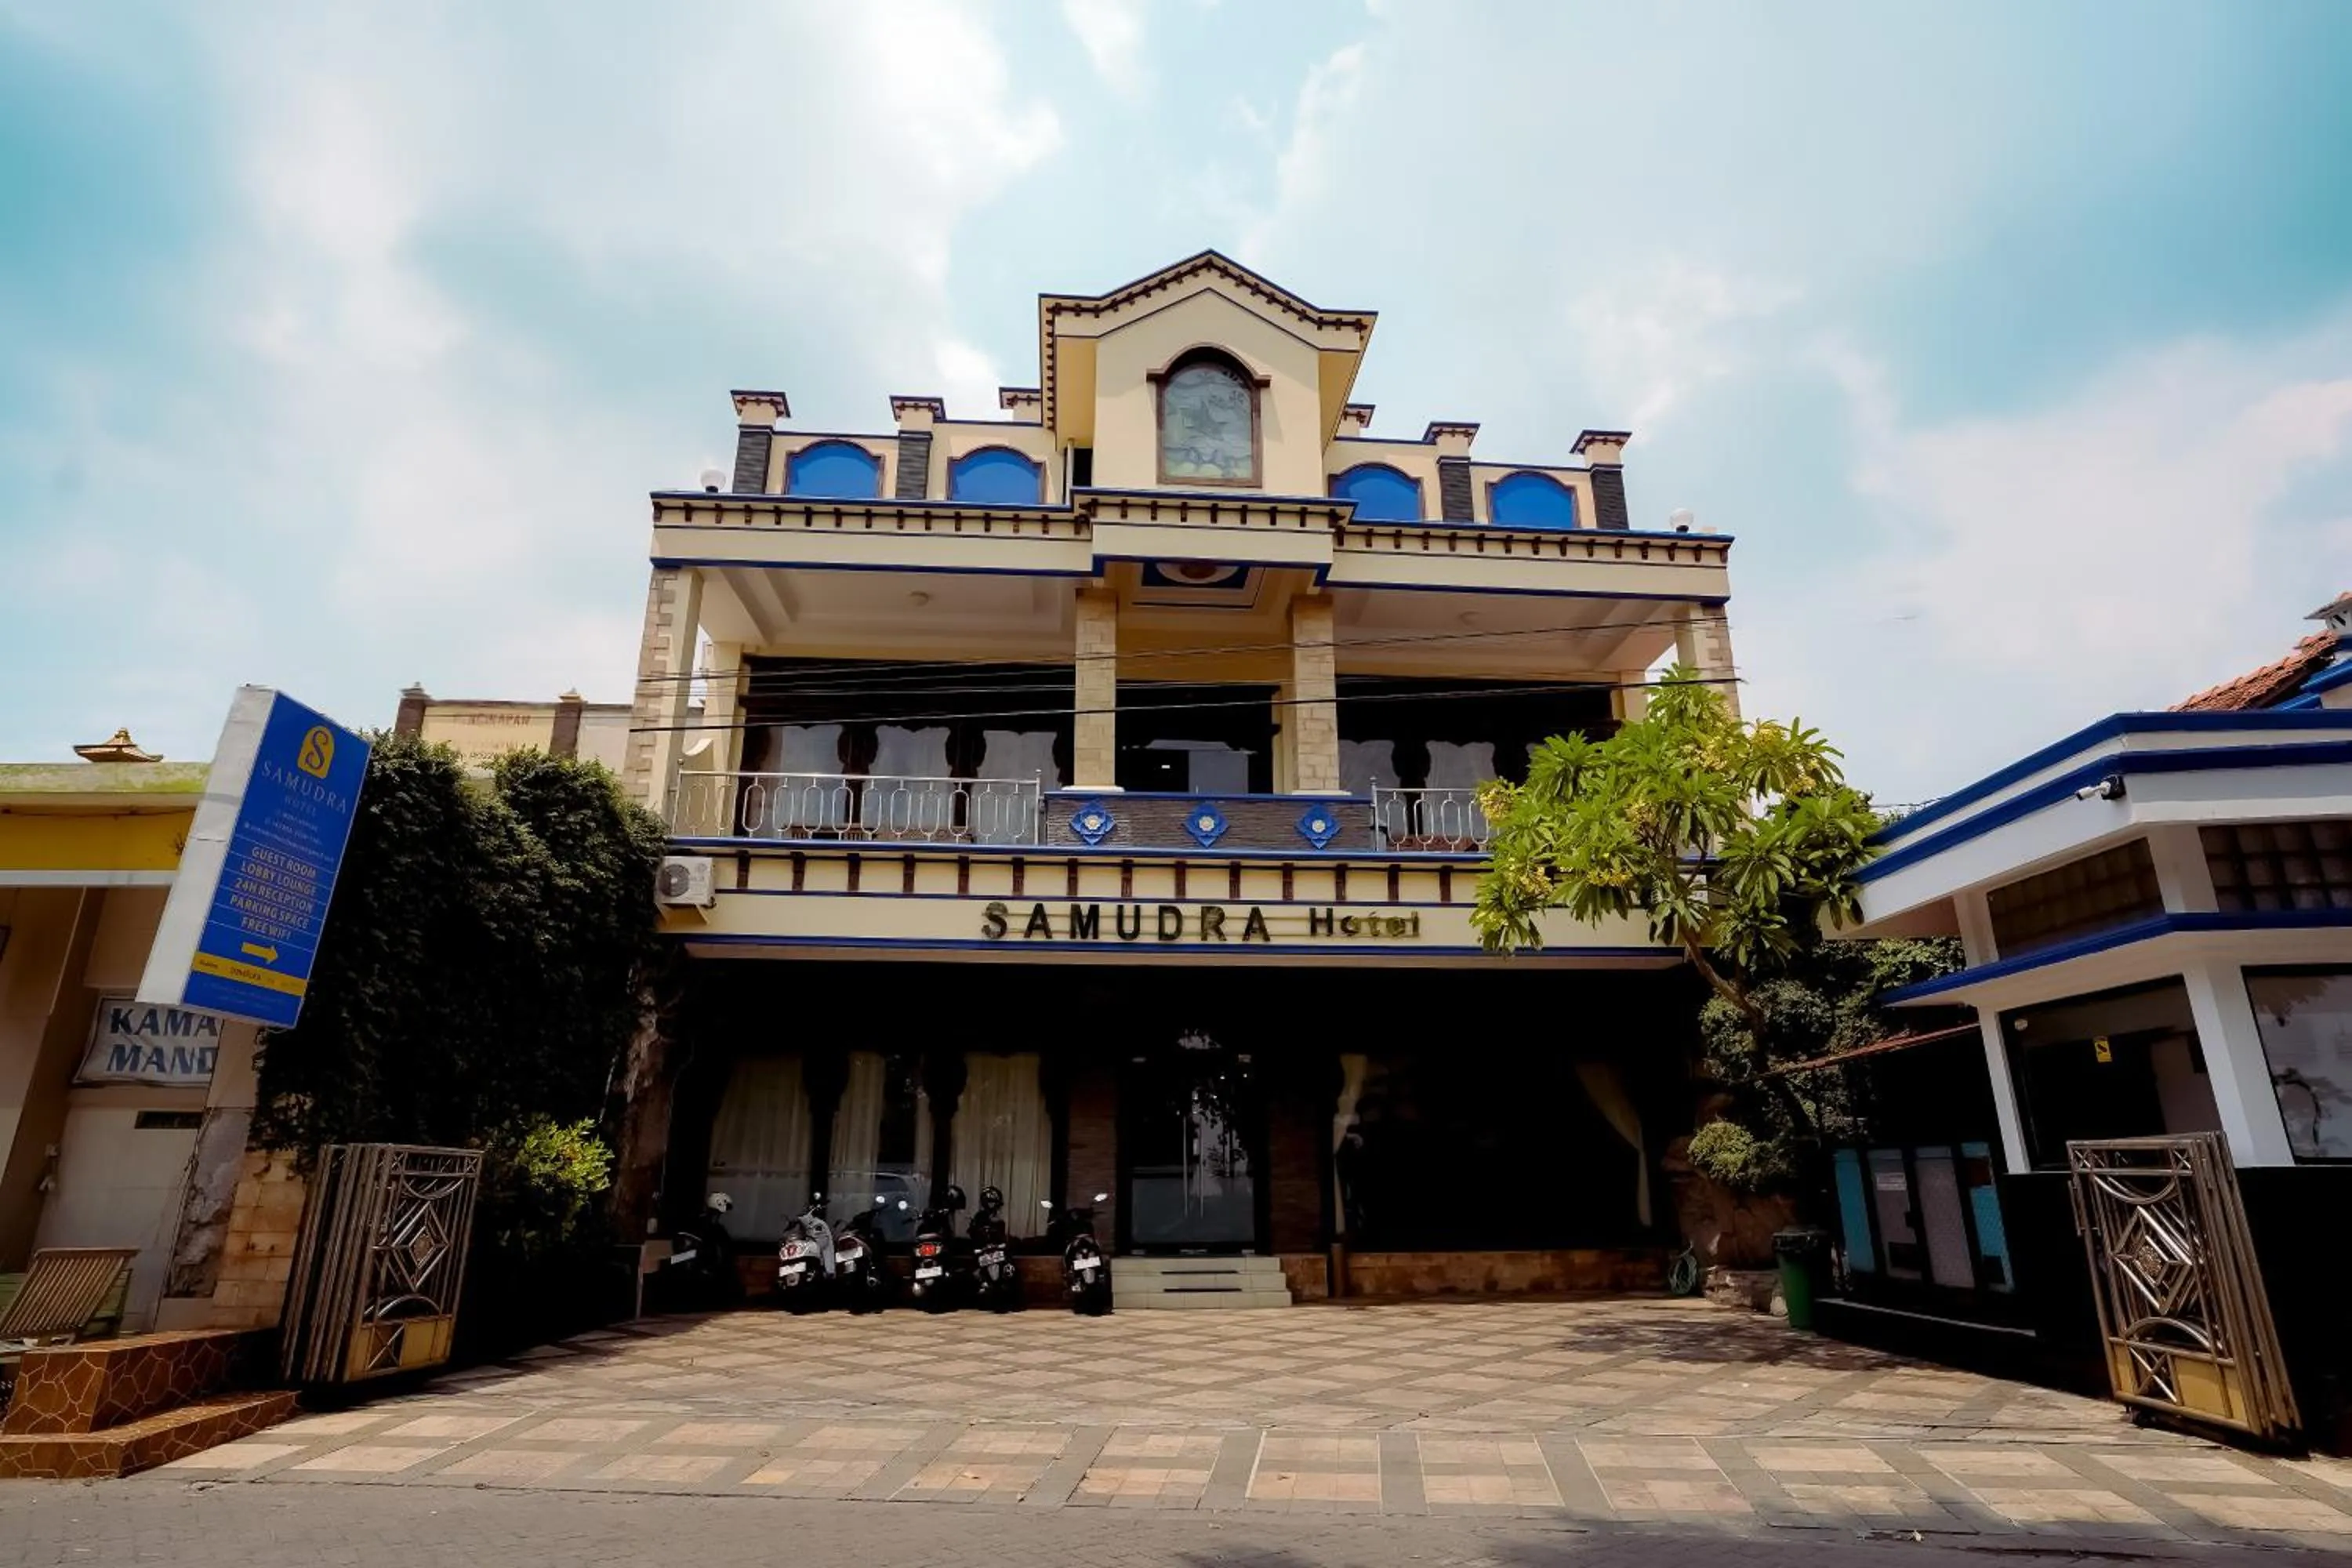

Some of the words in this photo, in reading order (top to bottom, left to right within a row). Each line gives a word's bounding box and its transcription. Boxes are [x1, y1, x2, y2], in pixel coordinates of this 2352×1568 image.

[262, 760, 347, 814] SAMUDRA
[241, 861, 276, 880] LOBBY
[278, 873, 317, 895] LOUNGE
[252, 846, 285, 866] GUEST
[286, 858, 317, 878] ROOM
[230, 895, 278, 919] PARKING
[280, 909, 310, 929] SPACE
[235, 878, 257, 894] 24H
[258, 885, 313, 913] RECEPTION
[241, 916, 267, 934] FREE
[268, 923, 292, 940] WIFI
[982, 901, 1271, 942] SAMUDRA
[1309, 907, 1420, 937] Hotel
